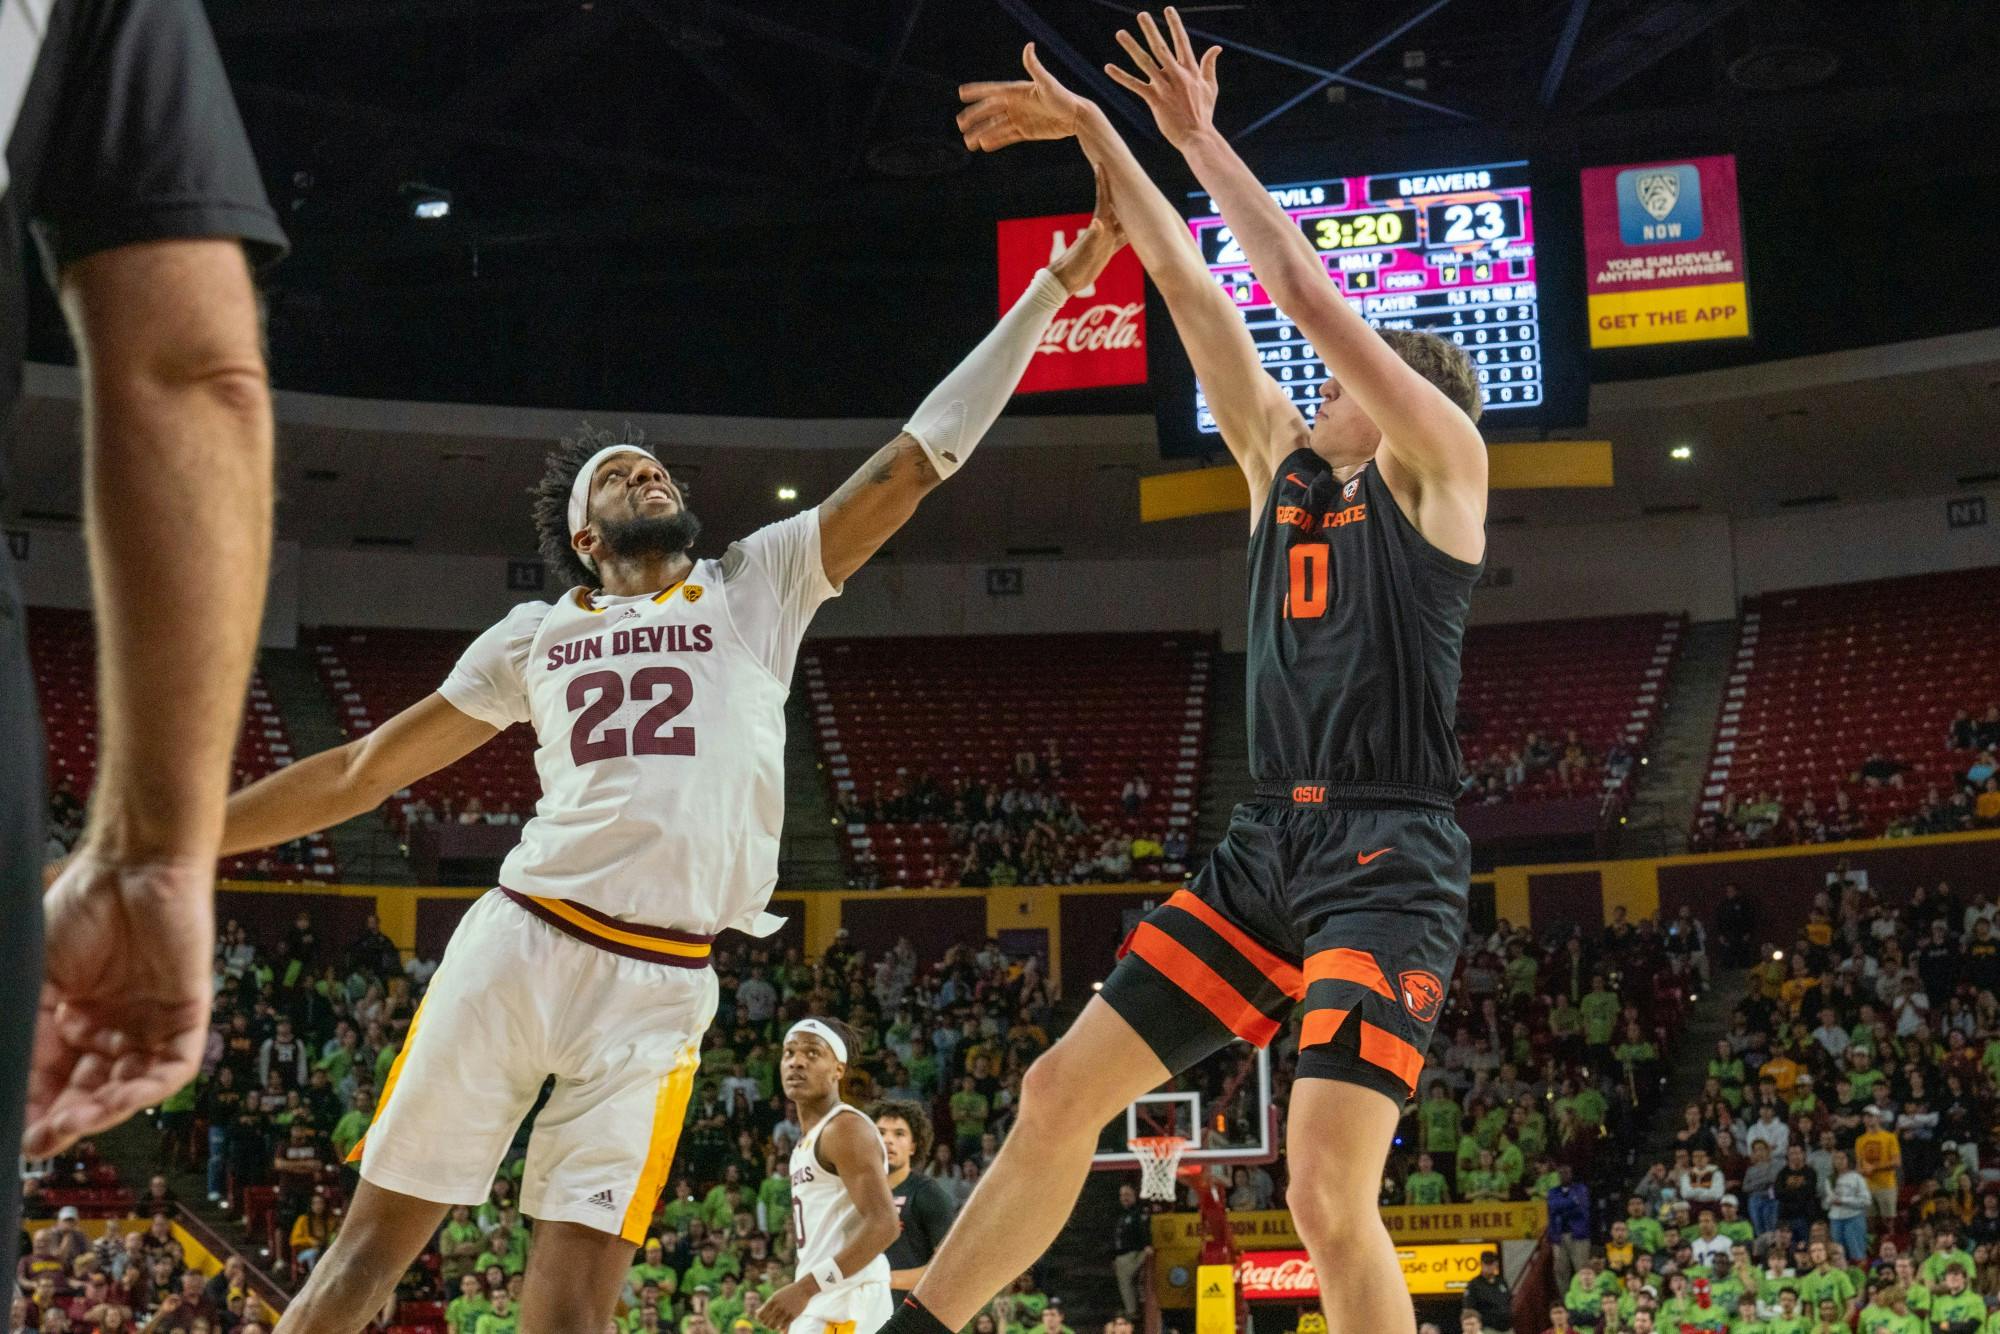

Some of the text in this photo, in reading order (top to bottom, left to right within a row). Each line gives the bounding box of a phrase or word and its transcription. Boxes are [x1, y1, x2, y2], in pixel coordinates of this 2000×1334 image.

[1399, 171, 1491, 196] BEAVERS
[1272, 187, 1325, 207] EVILS
[1316, 213, 1402, 249] 3:20
[1444, 202, 1505, 243] 23
[1643, 223, 1682, 240] NOW
[1217, 227, 1247, 263] 2
[1339, 252, 1383, 271] HALF
[1606, 256, 1645, 271] YOUR
[1646, 254, 1674, 268] SUN
[1356, 272, 1368, 288] 1
[1597, 261, 1734, 283] ANYTIME ANYWHERE
[1453, 312, 1463, 325] 1
[1496, 307, 1508, 321] 0
[1598, 305, 1737, 330] GET THE APP
[1280, 326, 1292, 340] 0
[1453, 326, 1531, 346] 0 0 1 0
[1500, 348, 1510, 362] 1
[1520, 346, 1532, 360] 0
[1281, 367, 1293, 380] 0
[1500, 367, 1511, 382] 0
[1521, 366, 1533, 380] 0
[1304, 385, 1316, 398] 4
[1501, 387, 1512, 402] 0
[1305, 404, 1316, 417] 4
[1322, 503, 1367, 528] TATE
[1289, 543, 1329, 618] 0
[547, 624, 713, 671] SUN DEVILS
[566, 666, 696, 767] 22
[1292, 786, 1326, 803] OSU
[1262, 1218, 1289, 1236] ALL
[1410, 1212, 1464, 1230] ENTER
[1470, 1211, 1513, 1228] HERE
[1432, 1257, 1449, 1273] of
